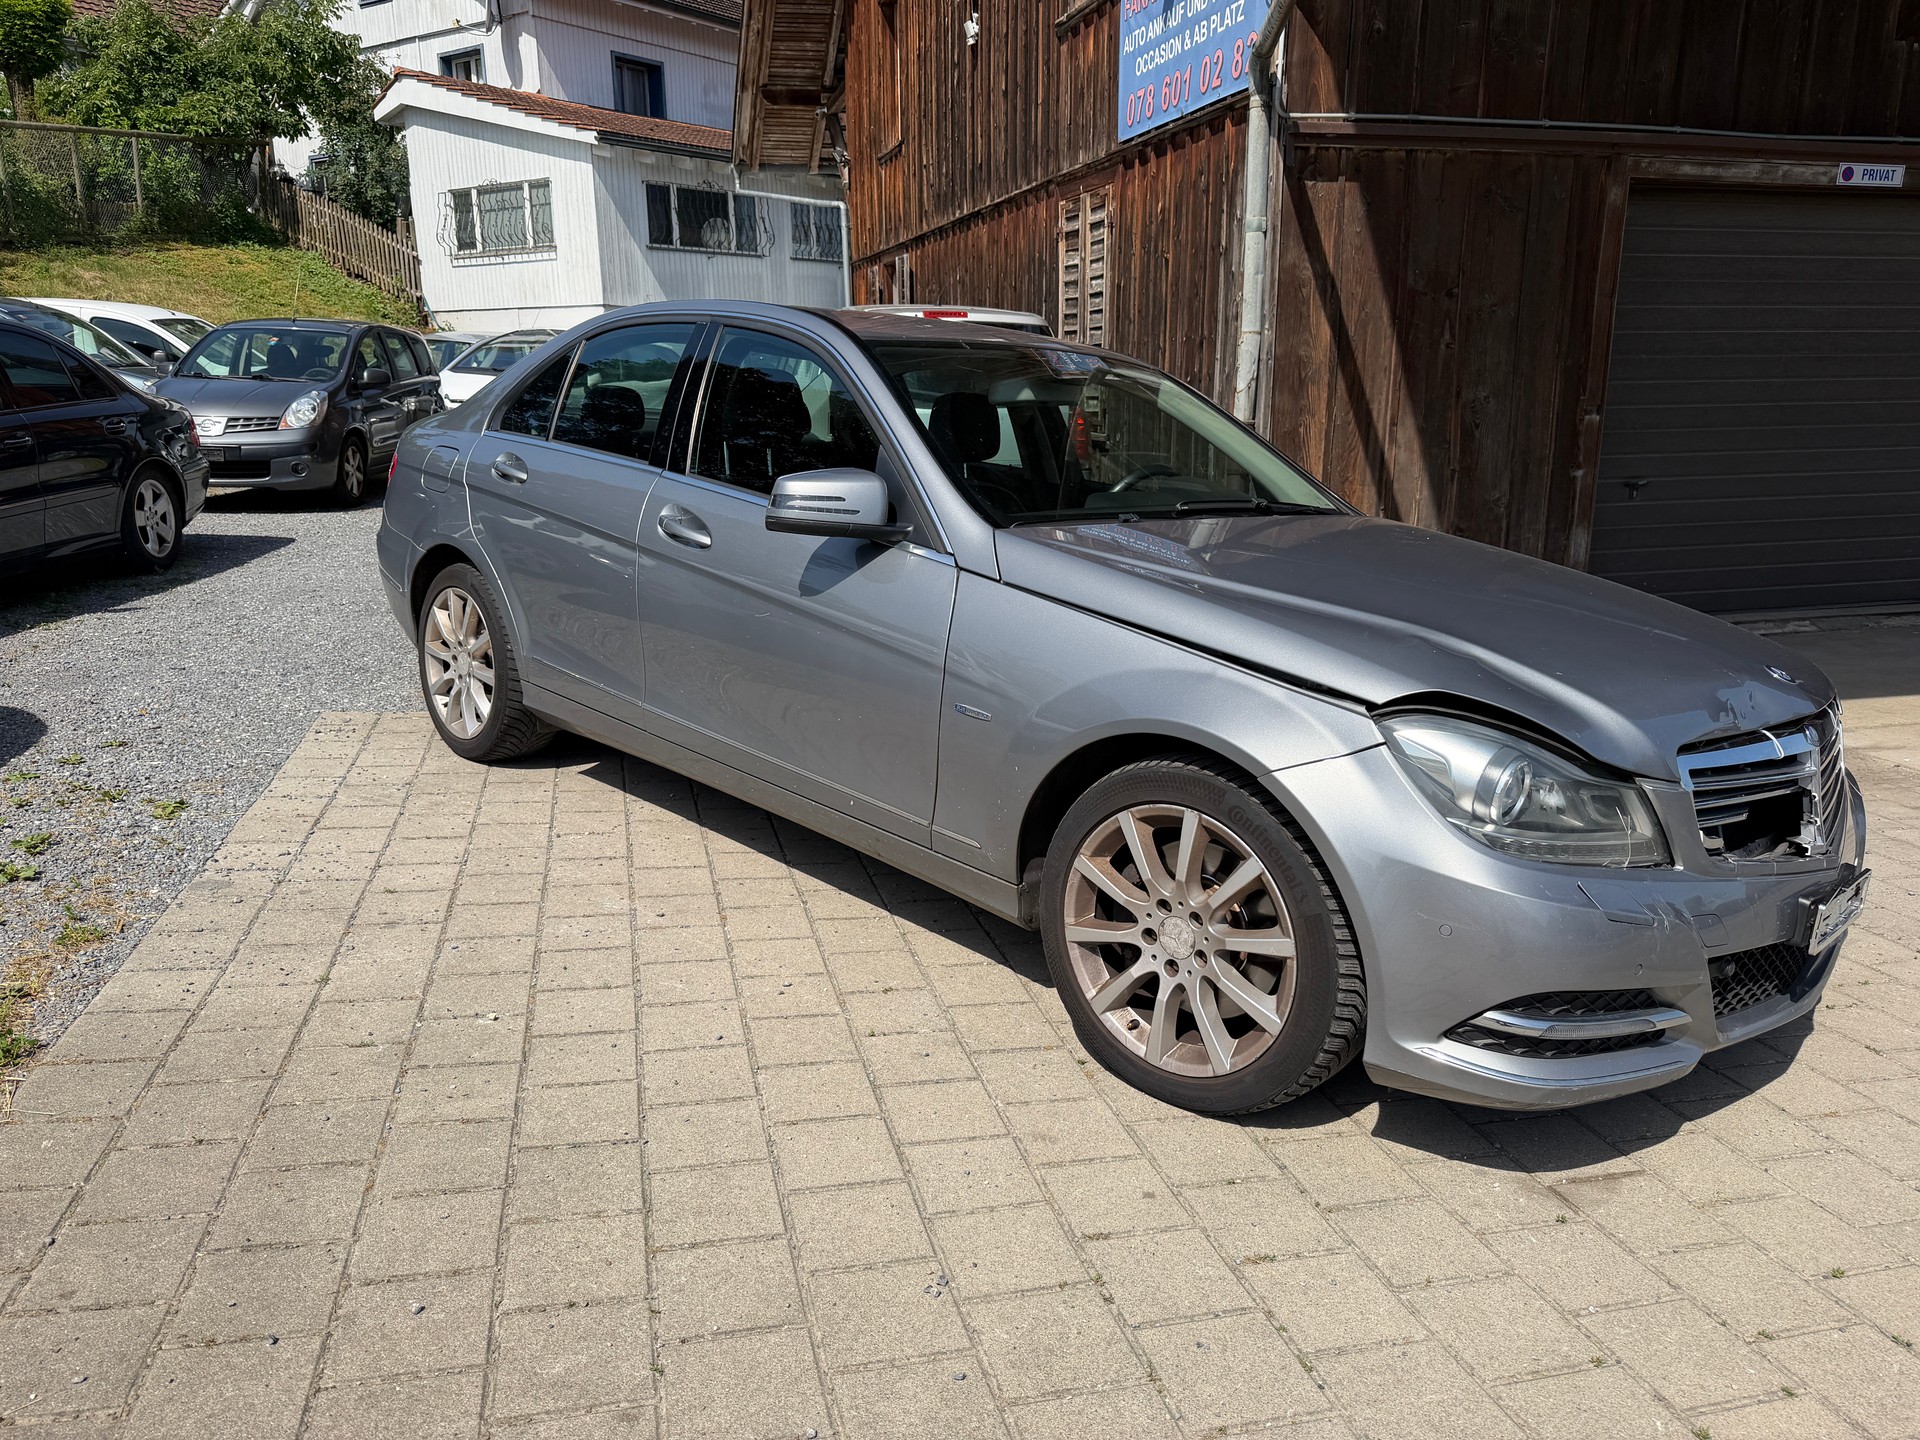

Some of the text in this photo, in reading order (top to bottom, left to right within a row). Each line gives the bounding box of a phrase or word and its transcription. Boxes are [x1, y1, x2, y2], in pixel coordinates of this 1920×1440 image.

[1123, 27, 1146, 56] AUTO
[1147, 4, 1185, 43] ANKAUF
[1135, 0, 1245, 76] OCCASION & AB PLATZ
[1126, 83, 1155, 127] 078
[1161, 63, 1192, 112] 601
[1200, 48, 1224, 95] 02
[1861, 168, 1897, 182] PRIVAT
[1227, 805, 1303, 890] Continental
